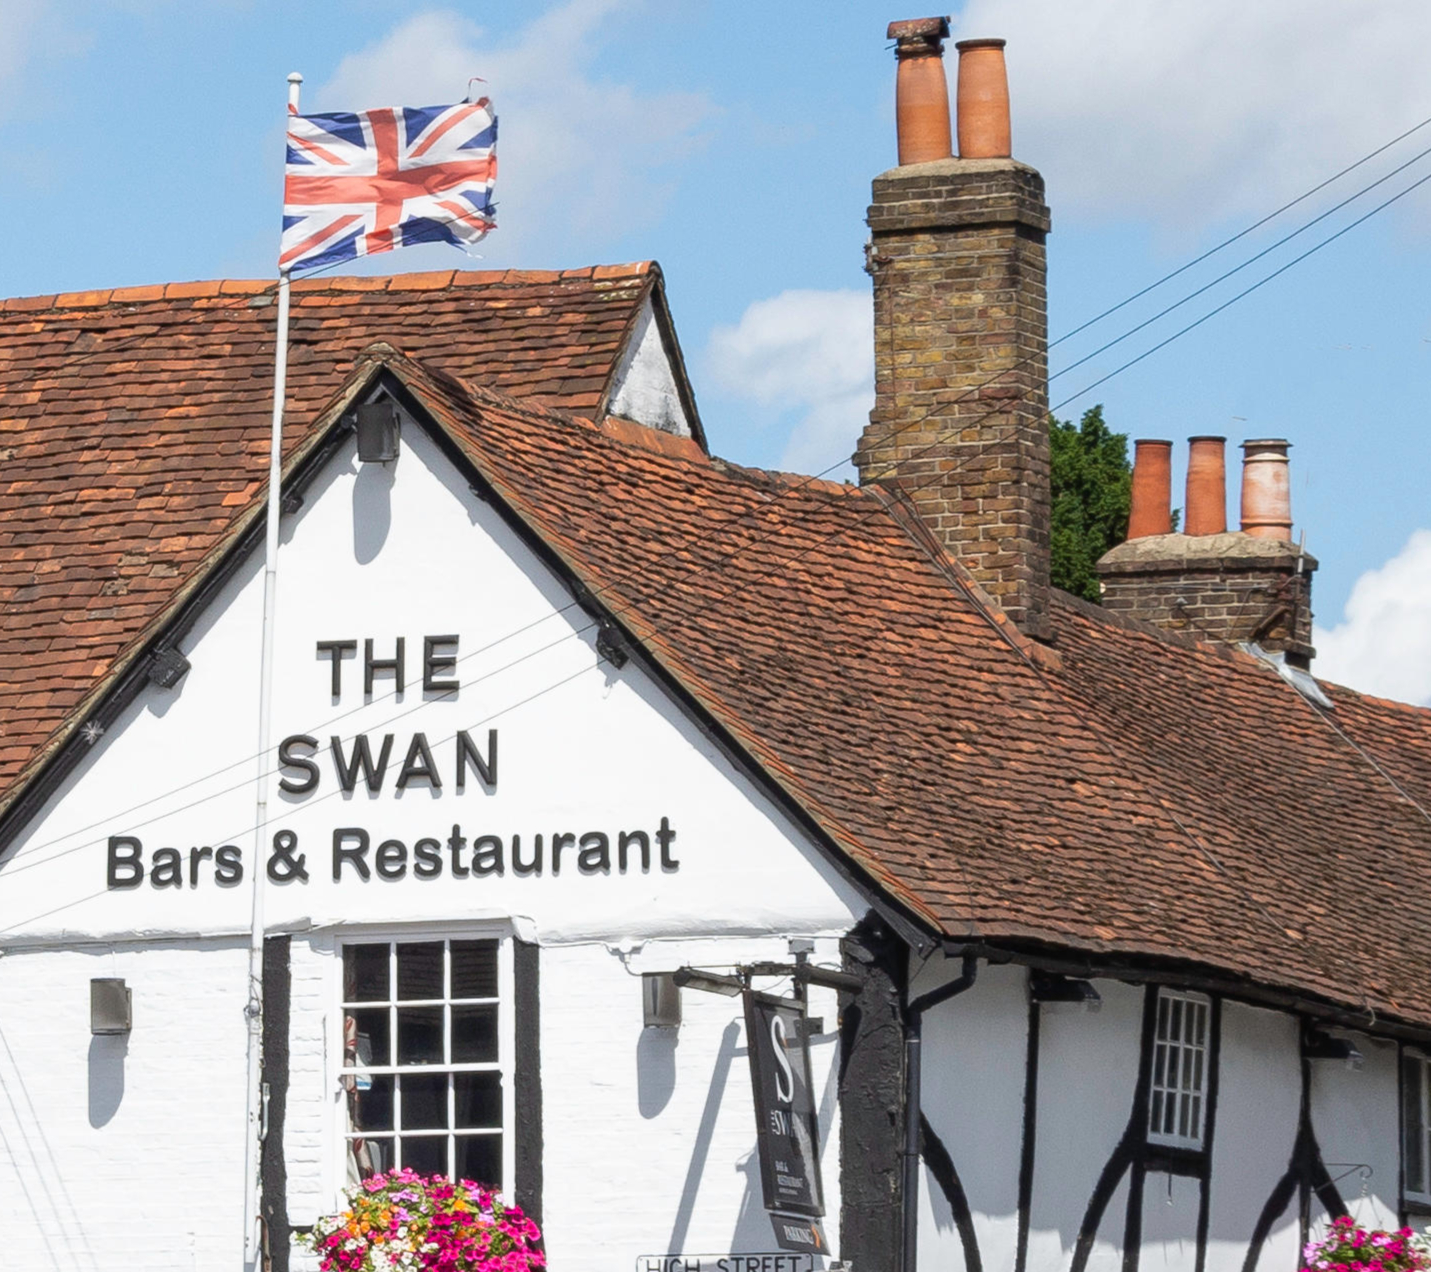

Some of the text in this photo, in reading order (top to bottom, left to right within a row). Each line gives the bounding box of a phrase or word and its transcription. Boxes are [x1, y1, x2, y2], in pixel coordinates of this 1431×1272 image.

[316, 634, 460, 697] THE
[278, 729, 498, 795] SWAN
[106, 816, 679, 887] Bars & Restaurant
